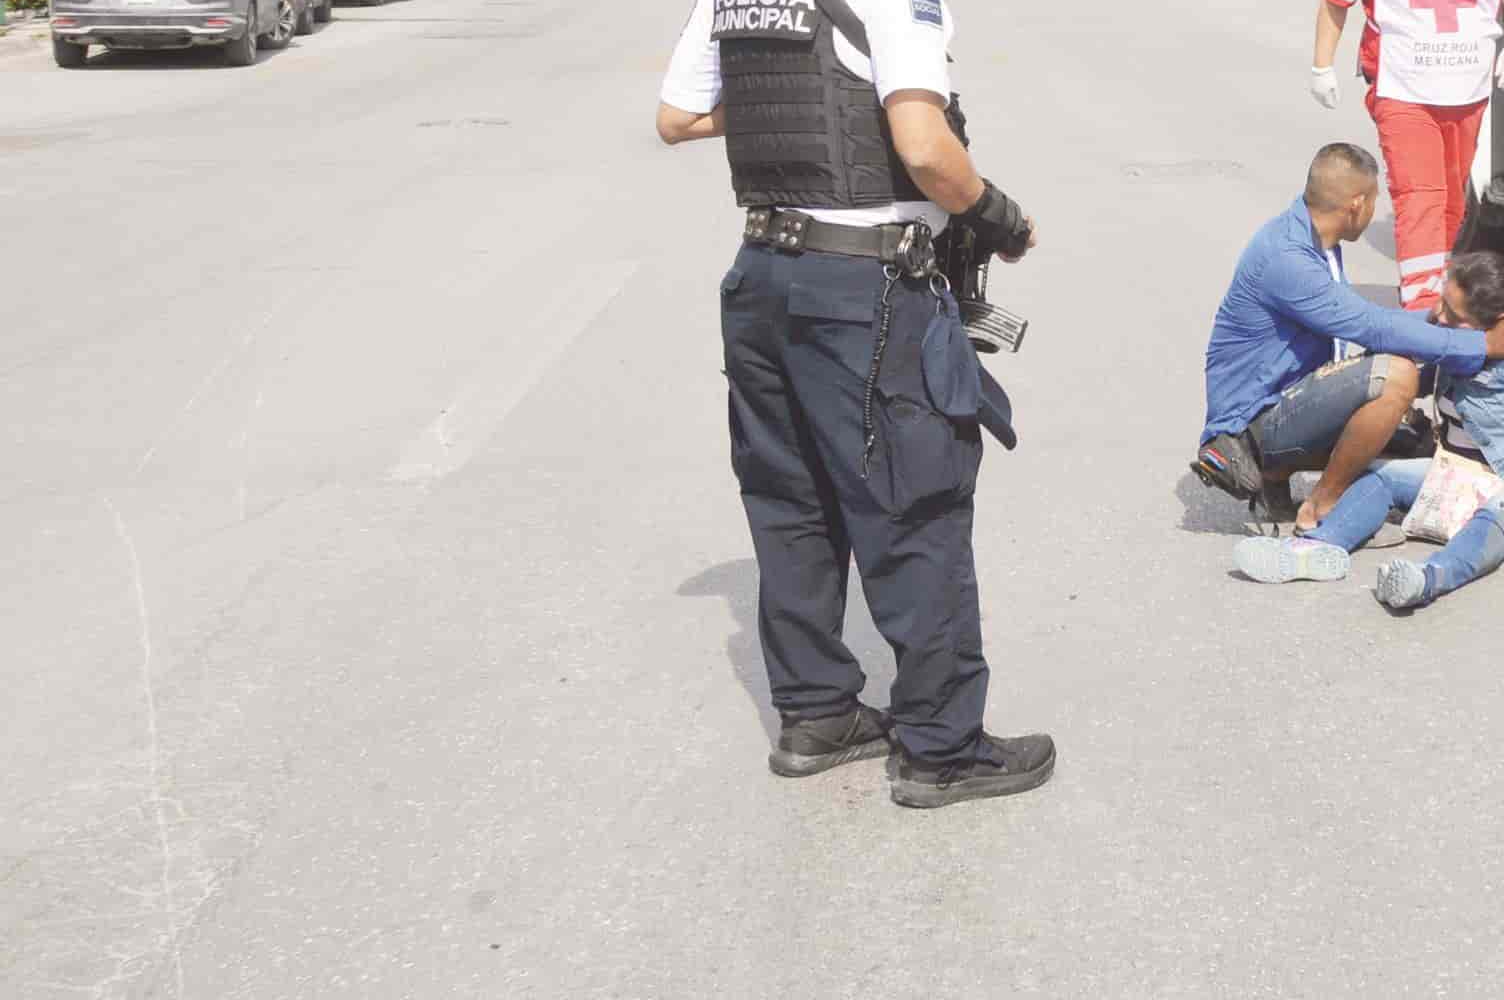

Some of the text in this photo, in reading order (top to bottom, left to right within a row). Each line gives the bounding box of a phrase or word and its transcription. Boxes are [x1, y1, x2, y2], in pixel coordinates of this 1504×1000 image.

[1414, 40, 1479, 55] CRUZ ROJA
[1414, 55, 1480, 68] MEXICANA
